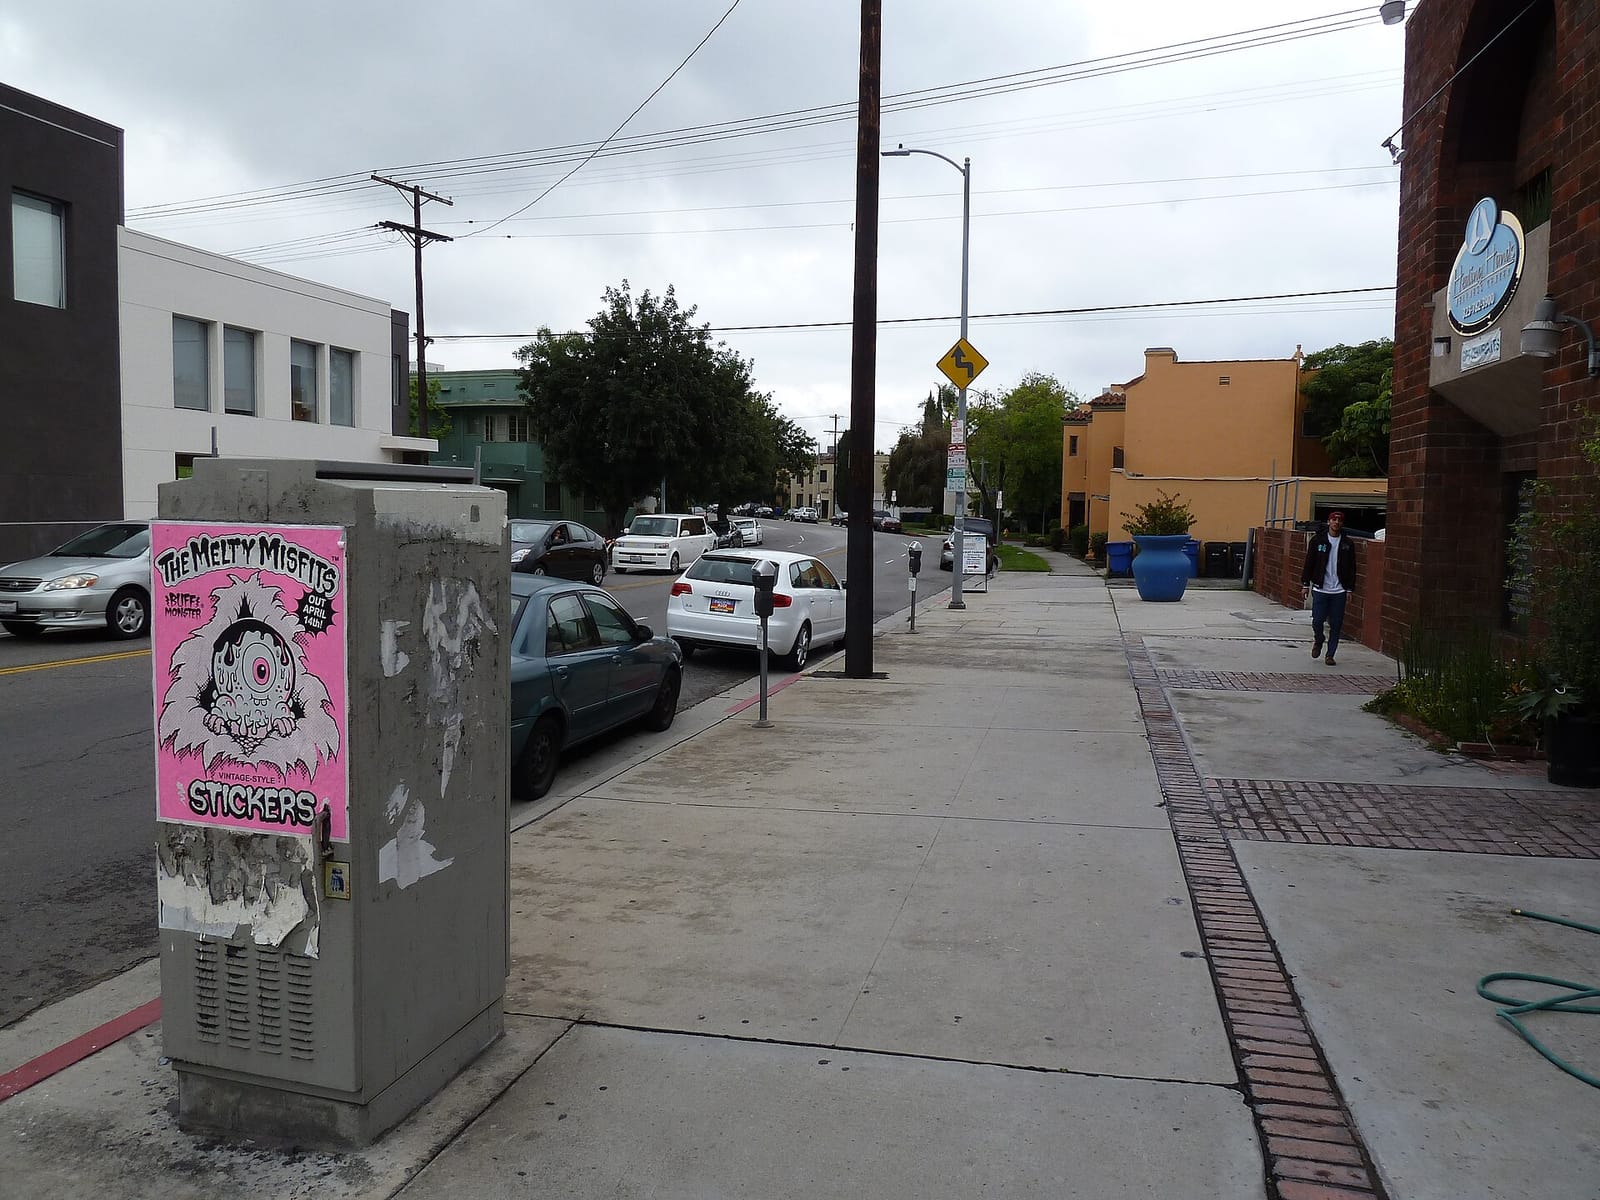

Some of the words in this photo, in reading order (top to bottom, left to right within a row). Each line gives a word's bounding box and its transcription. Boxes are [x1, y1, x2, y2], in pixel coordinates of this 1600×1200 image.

[157, 551, 190, 582] THE
[190, 537, 256, 572] MELTY
[259, 536, 337, 594] MISFITS
[168, 592, 198, 608] BUFF
[308, 594, 326, 608] OUT
[165, 606, 202, 619] MONSTER
[303, 604, 327, 620] APRIL
[303, 615, 324, 630] 14th!
[219, 771, 276, 785] VINTAGE-STYLE
[188, 779, 317, 826] STICKERS
